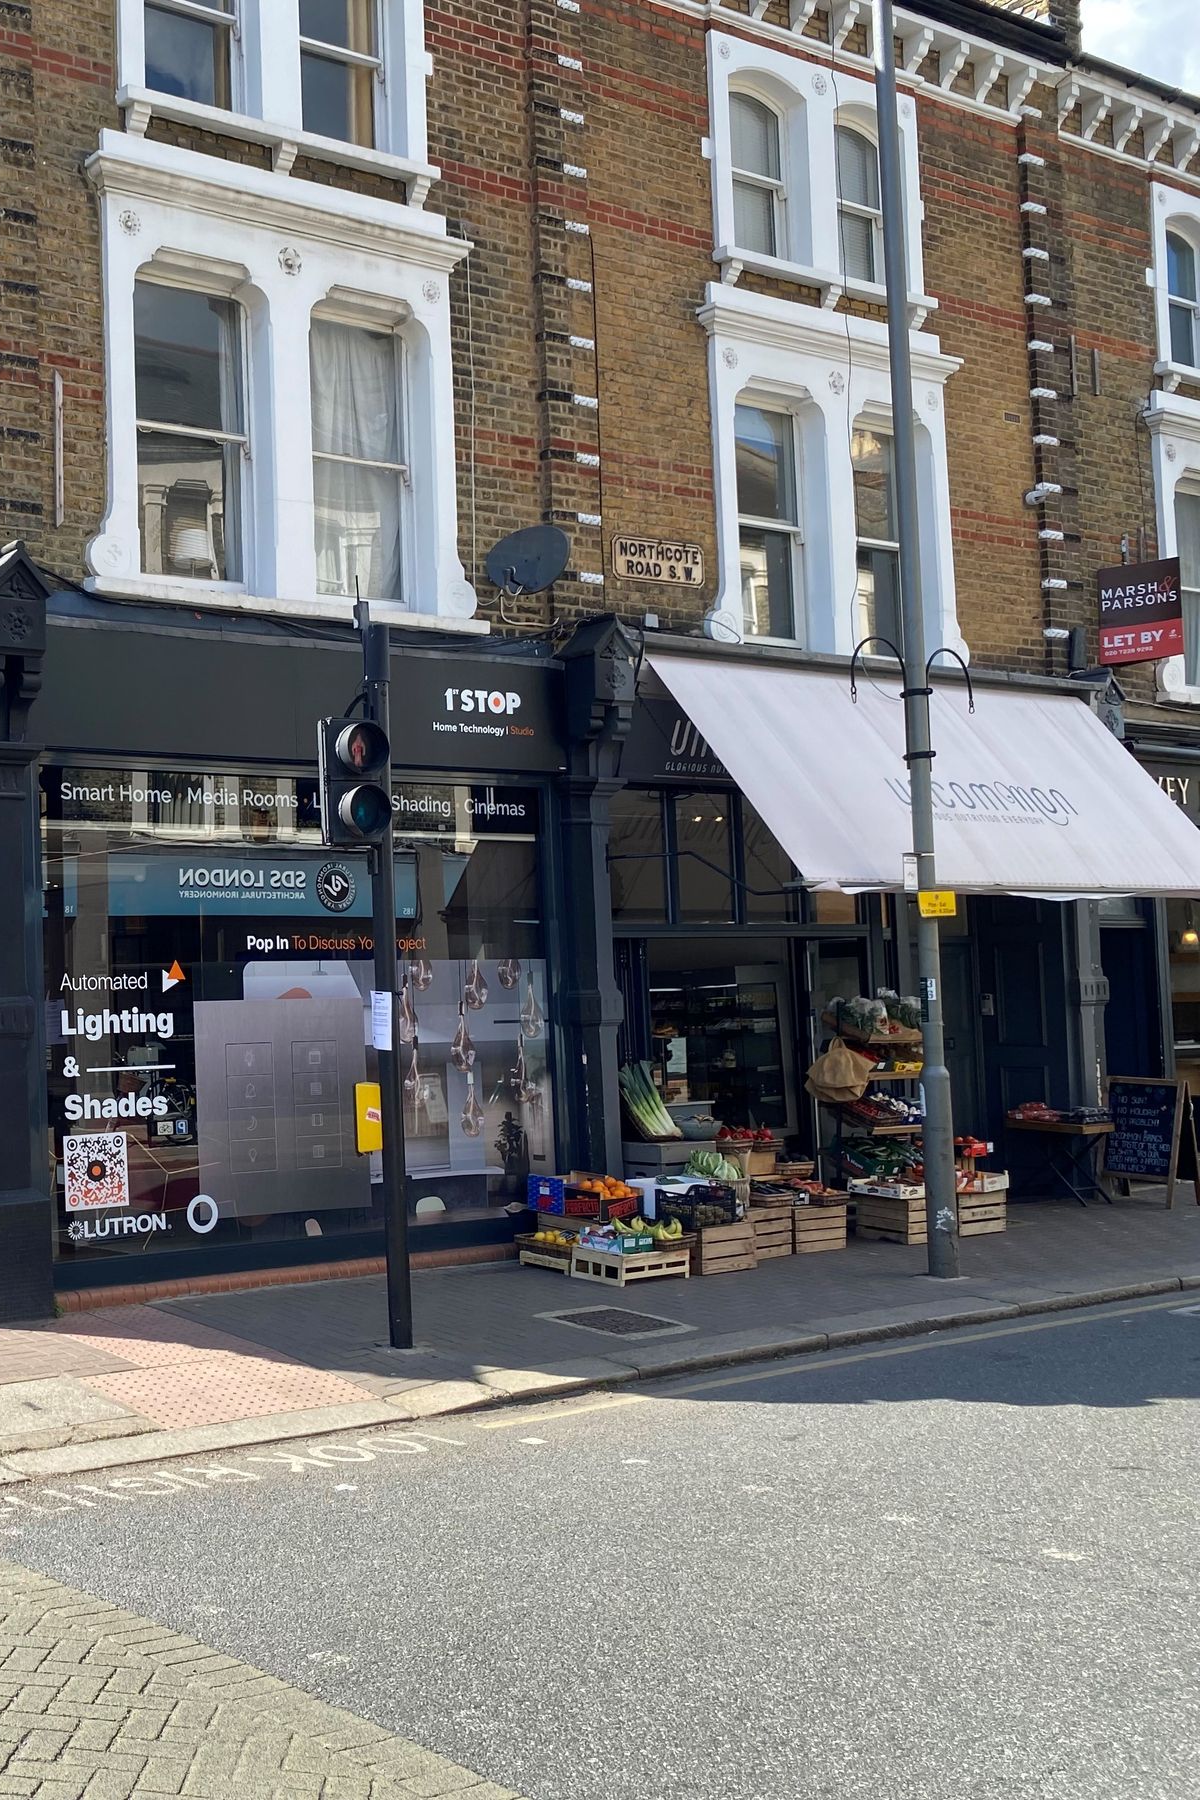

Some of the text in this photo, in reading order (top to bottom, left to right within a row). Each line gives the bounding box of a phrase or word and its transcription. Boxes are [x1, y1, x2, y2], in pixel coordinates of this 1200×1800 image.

[619, 541, 700, 565] NORTHCOTE
[626, 560, 662, 577] ROAD
[1101, 575, 1178, 599] MARSH &
[1101, 591, 1177, 612] PARSONS
[1102, 633, 1135, 648] LET
[1140, 630, 1164, 643] BY
[460, 689, 521, 714] STOP
[432, 722, 534, 736] Home Technology Studio
[60, 782, 115, 802] Smart
[119, 785, 172, 803] Home
[187, 787, 239, 805] Media
[243, 789, 299, 808] Rooms
[391, 795, 526, 817] Shading Cinemas
[246, 935, 274, 952] Pop
[276, 935, 289, 950] In
[291, 935, 306, 950] To
[309, 935, 356, 950] Discuss
[358, 935, 375, 950] Yo
[60, 971, 148, 991] Automated
[61, 1006, 174, 1041] Lighting
[62, 1056, 80, 1078] &
[64, 1092, 169, 1121] Shades
[247, 1431, 467, 1473] LOOK
